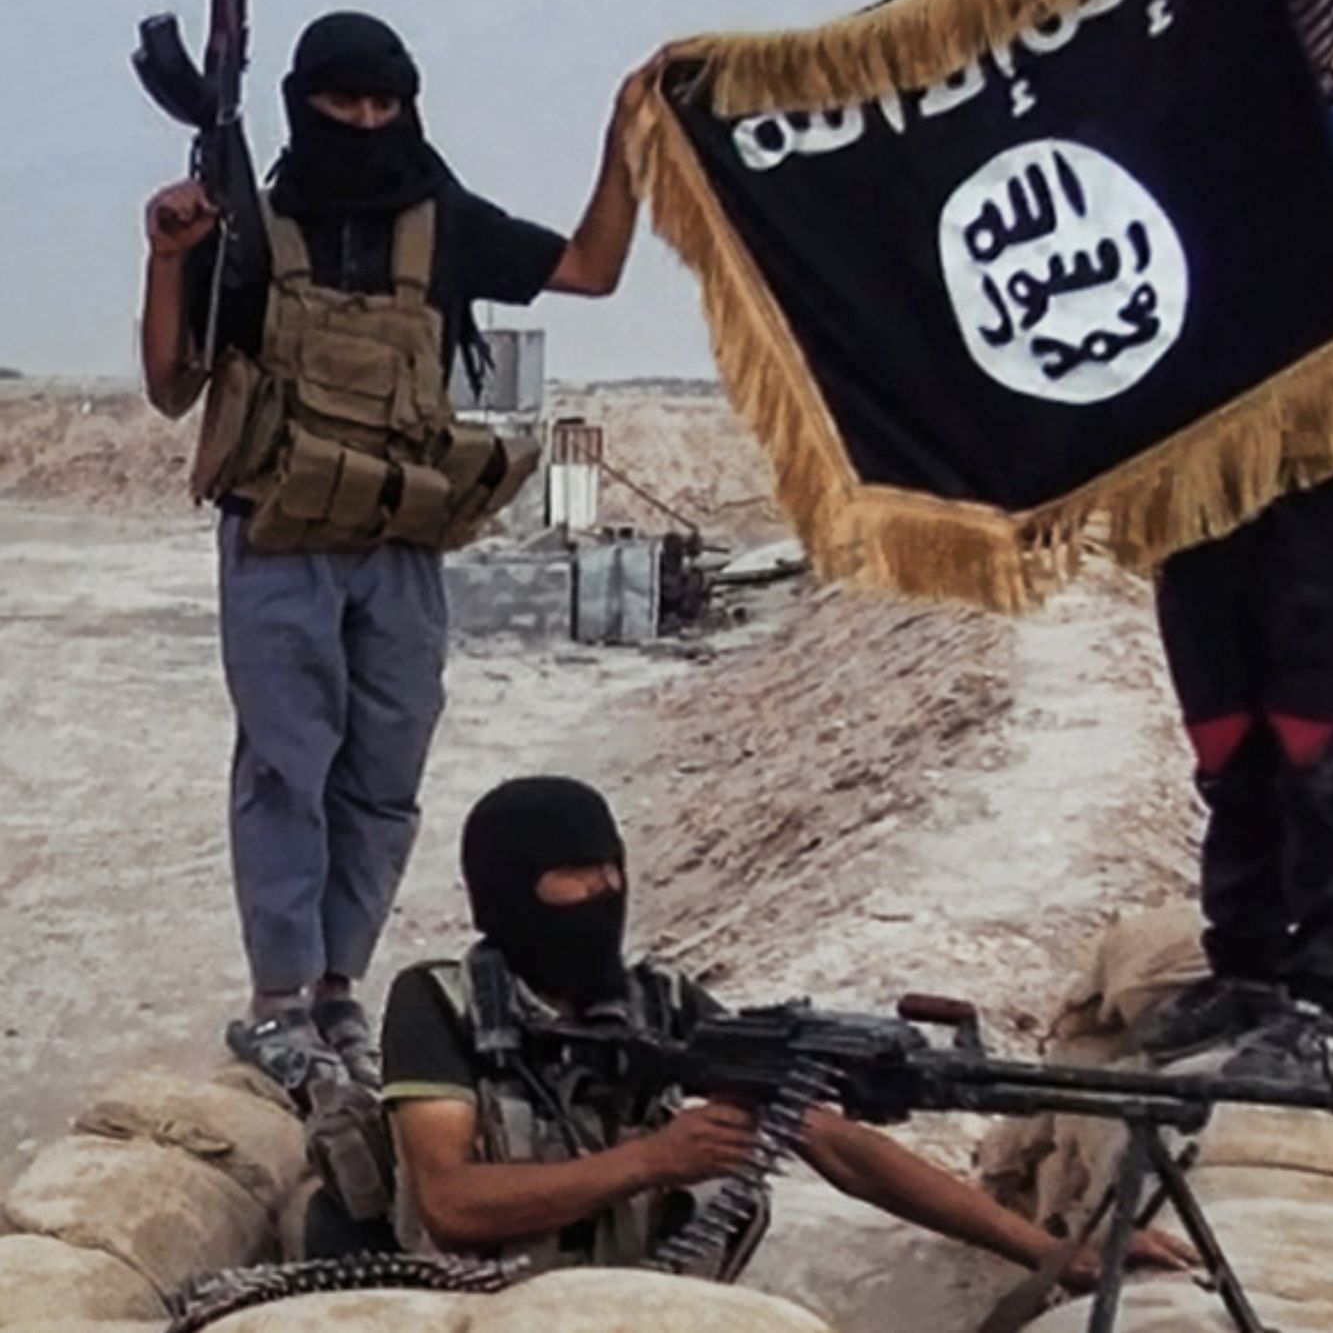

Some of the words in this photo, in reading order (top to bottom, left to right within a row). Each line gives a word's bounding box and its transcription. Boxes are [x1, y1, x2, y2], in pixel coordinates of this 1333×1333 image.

[964, 150, 1087, 263] الله
[978, 220, 1151, 348] رسول
[1031, 282, 1160, 380] محمد
